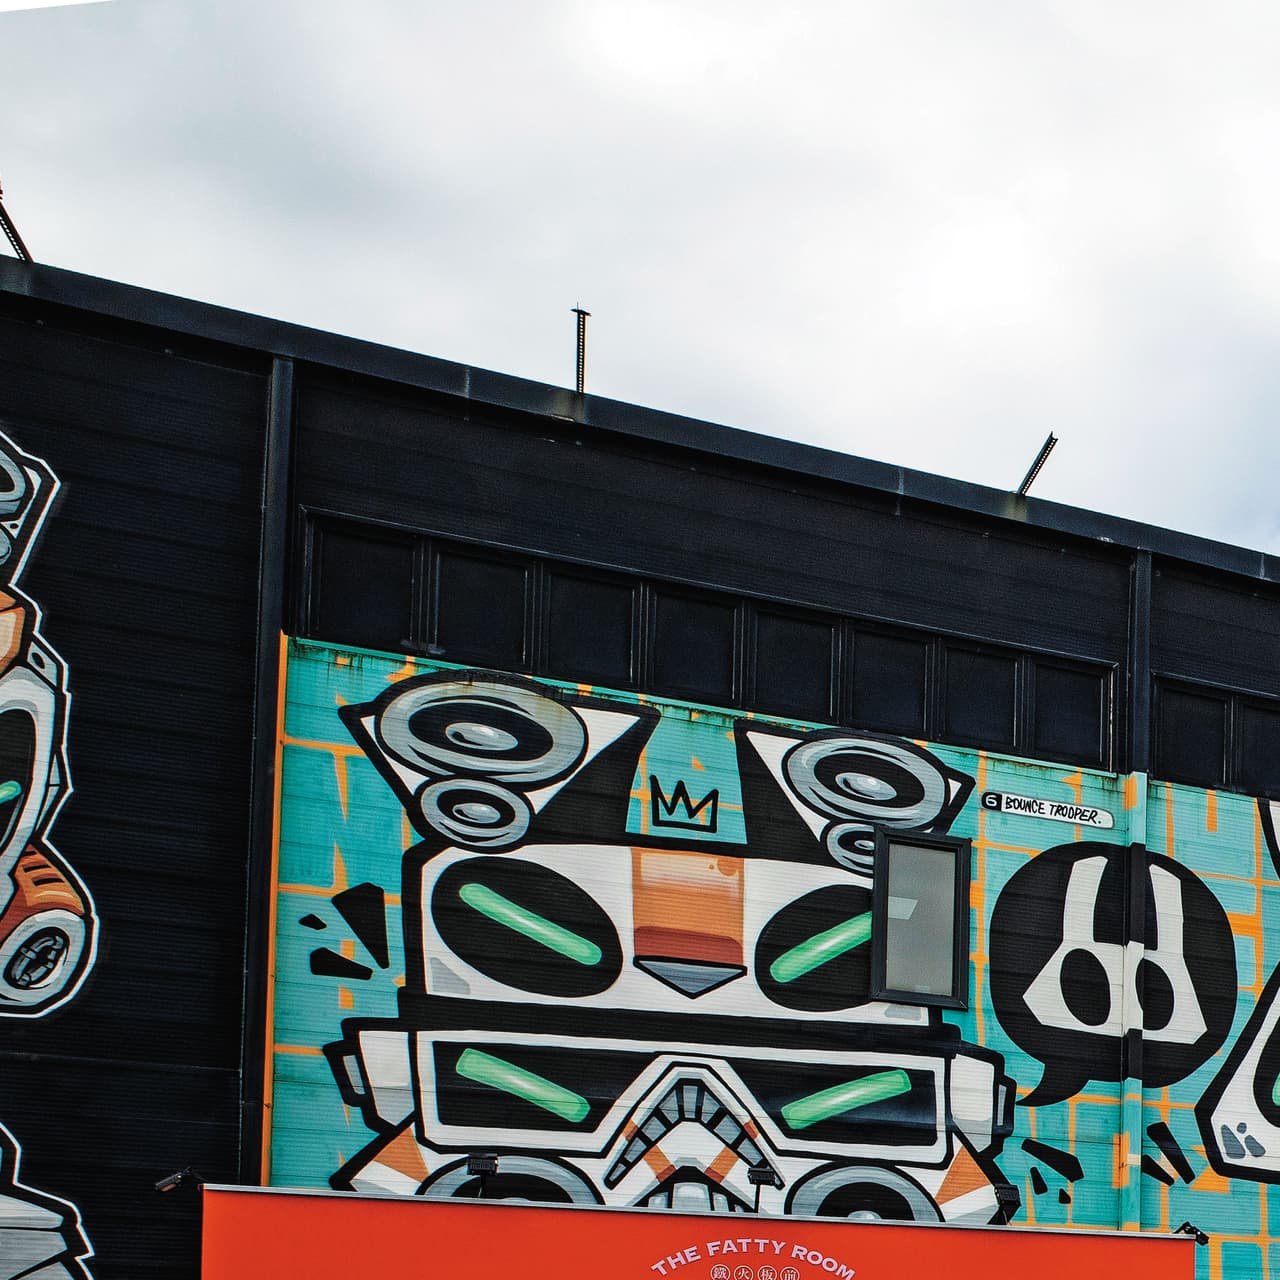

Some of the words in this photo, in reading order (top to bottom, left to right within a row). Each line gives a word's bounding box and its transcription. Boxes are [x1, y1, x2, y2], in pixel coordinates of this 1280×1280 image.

[986, 794, 998, 806] 6
[1005, 796, 1045, 815] BOUNCE
[1049, 804, 1102, 824] TROOPER.
[651, 1246, 701, 1277] THE
[706, 1238, 786, 1257] FATTY
